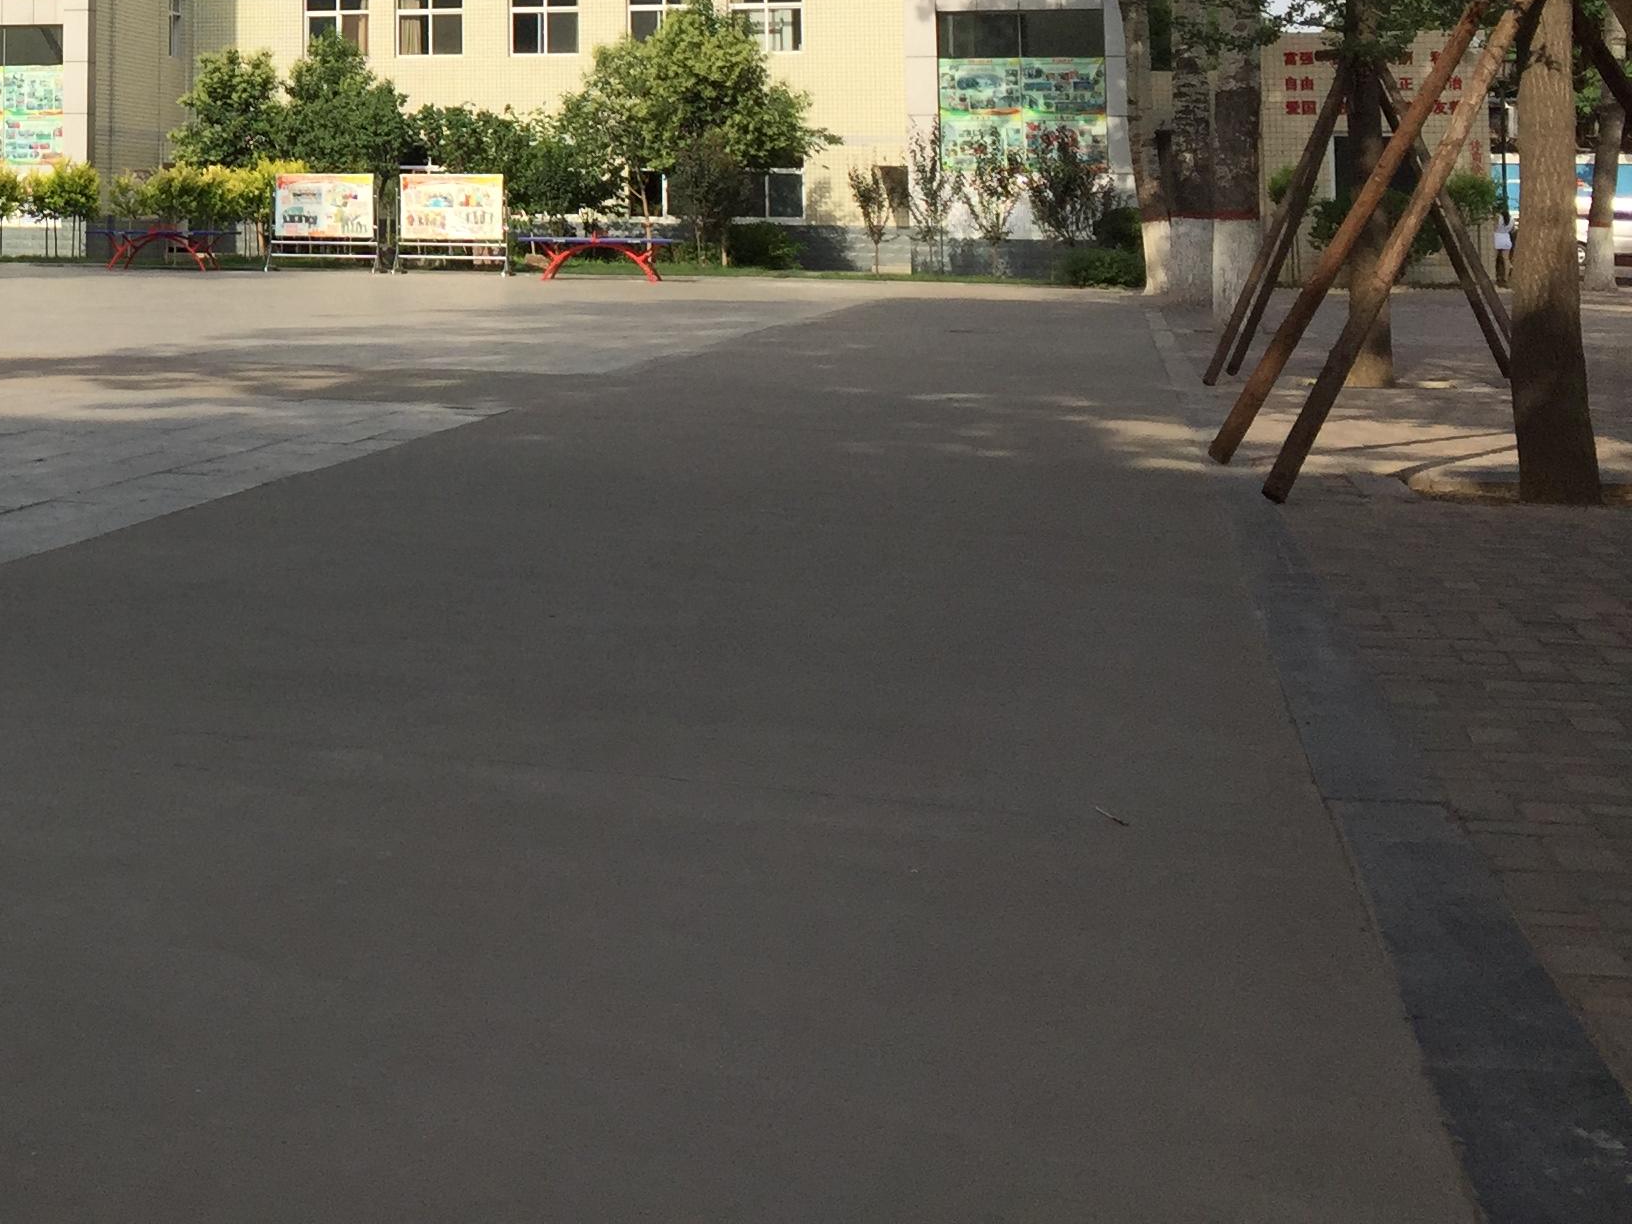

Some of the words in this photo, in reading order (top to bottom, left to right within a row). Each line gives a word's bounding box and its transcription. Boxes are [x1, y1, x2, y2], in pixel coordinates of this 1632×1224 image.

[1283, 51, 1314, 66] 富强
[1285, 76, 1314, 91] 自由
[1285, 100, 1317, 115] 爱国
